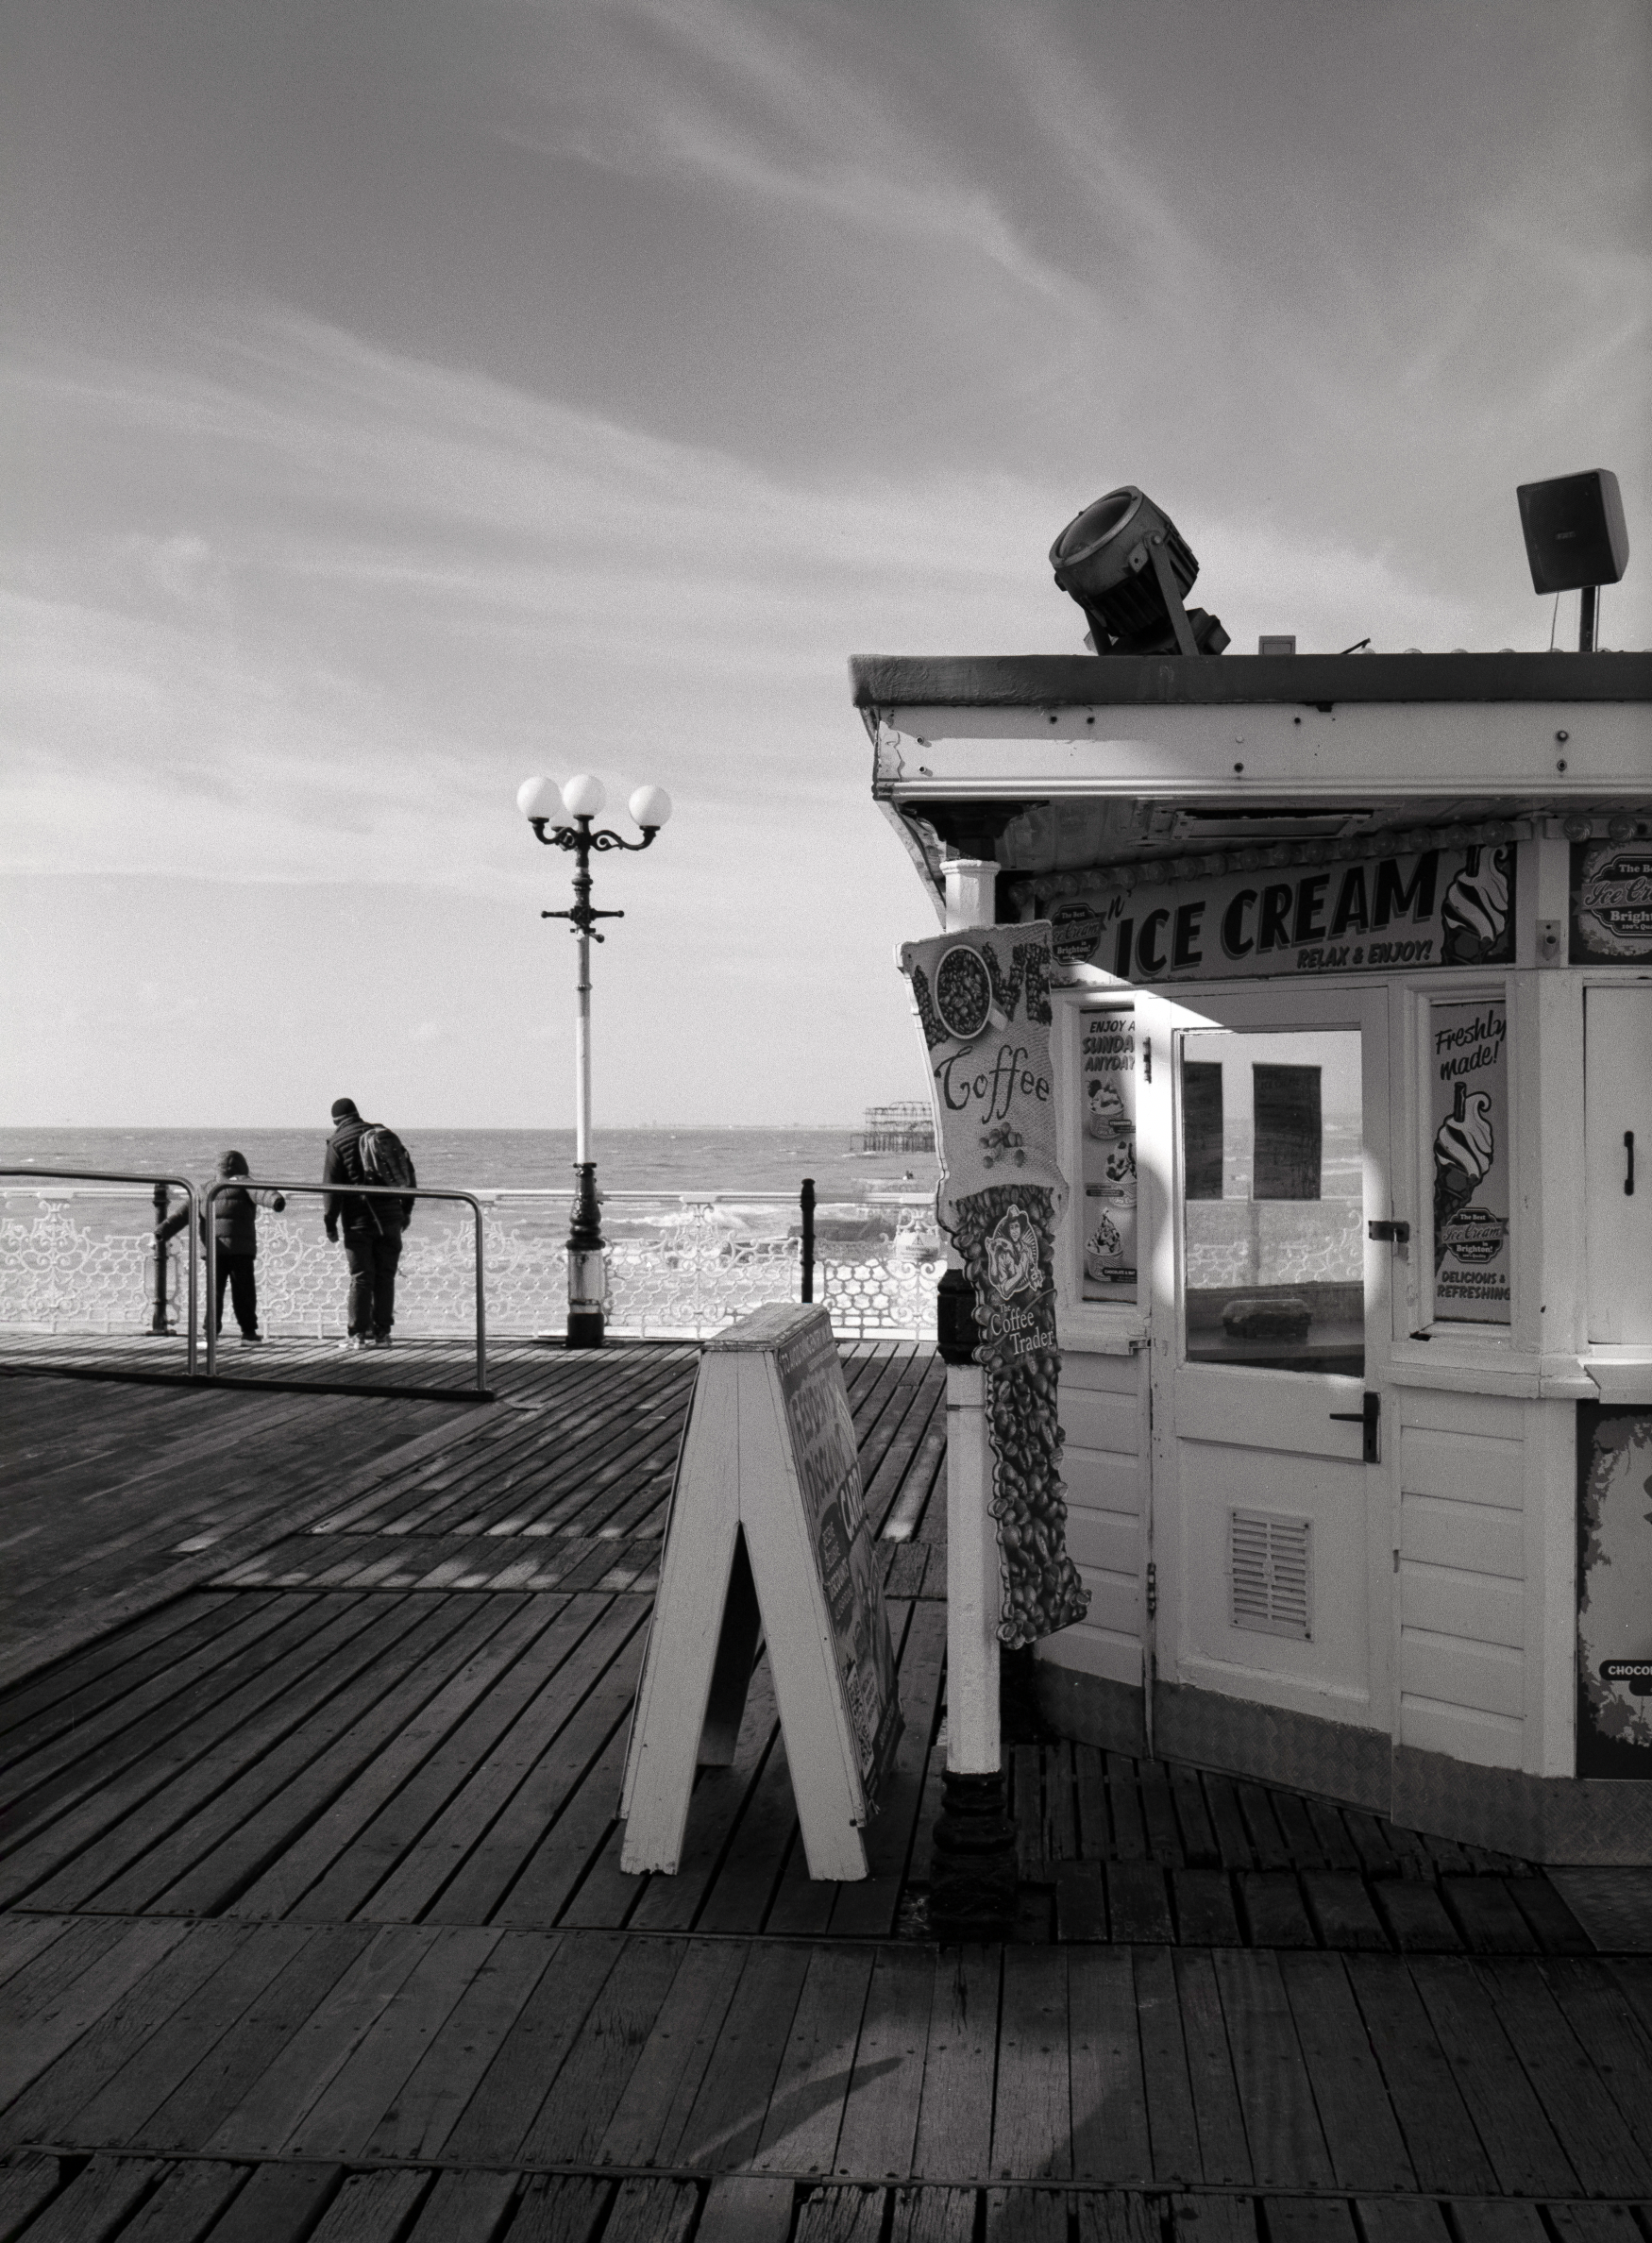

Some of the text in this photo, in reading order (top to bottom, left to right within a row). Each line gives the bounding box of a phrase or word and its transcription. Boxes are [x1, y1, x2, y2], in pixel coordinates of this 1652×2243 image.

[1619, 864, 1640, 872] The
[1584, 880, 1624, 906] Ice
[1115, 901, 1206, 978] ICE
[1221, 848, 1440, 960] CREAM
[1065, 919, 1100, 940] Cream
[1056, 945, 1091, 954] Brighton!
[1297, 939, 1433, 970] RELAX & ENJOY!
[1089, 1020, 1136, 1033] ENJOY A
[1435, 1009, 1507, 1054] Freshly
[1440, 1040, 1499, 1080] made!
[934, 1044, 1051, 1125] Coffee
[1442, 1222, 1502, 1241] Ice Cream
[1456, 1244, 1493, 1254] Brighton!
[1441, 1271, 1506, 1284] DELICIOUS &
[1437, 1284, 1510, 1301] REFRESHING
[999, 1303, 1011, 1313] The
[990, 1307, 1035, 1336] Coffee
[1009, 1326, 1054, 1356] Trader
